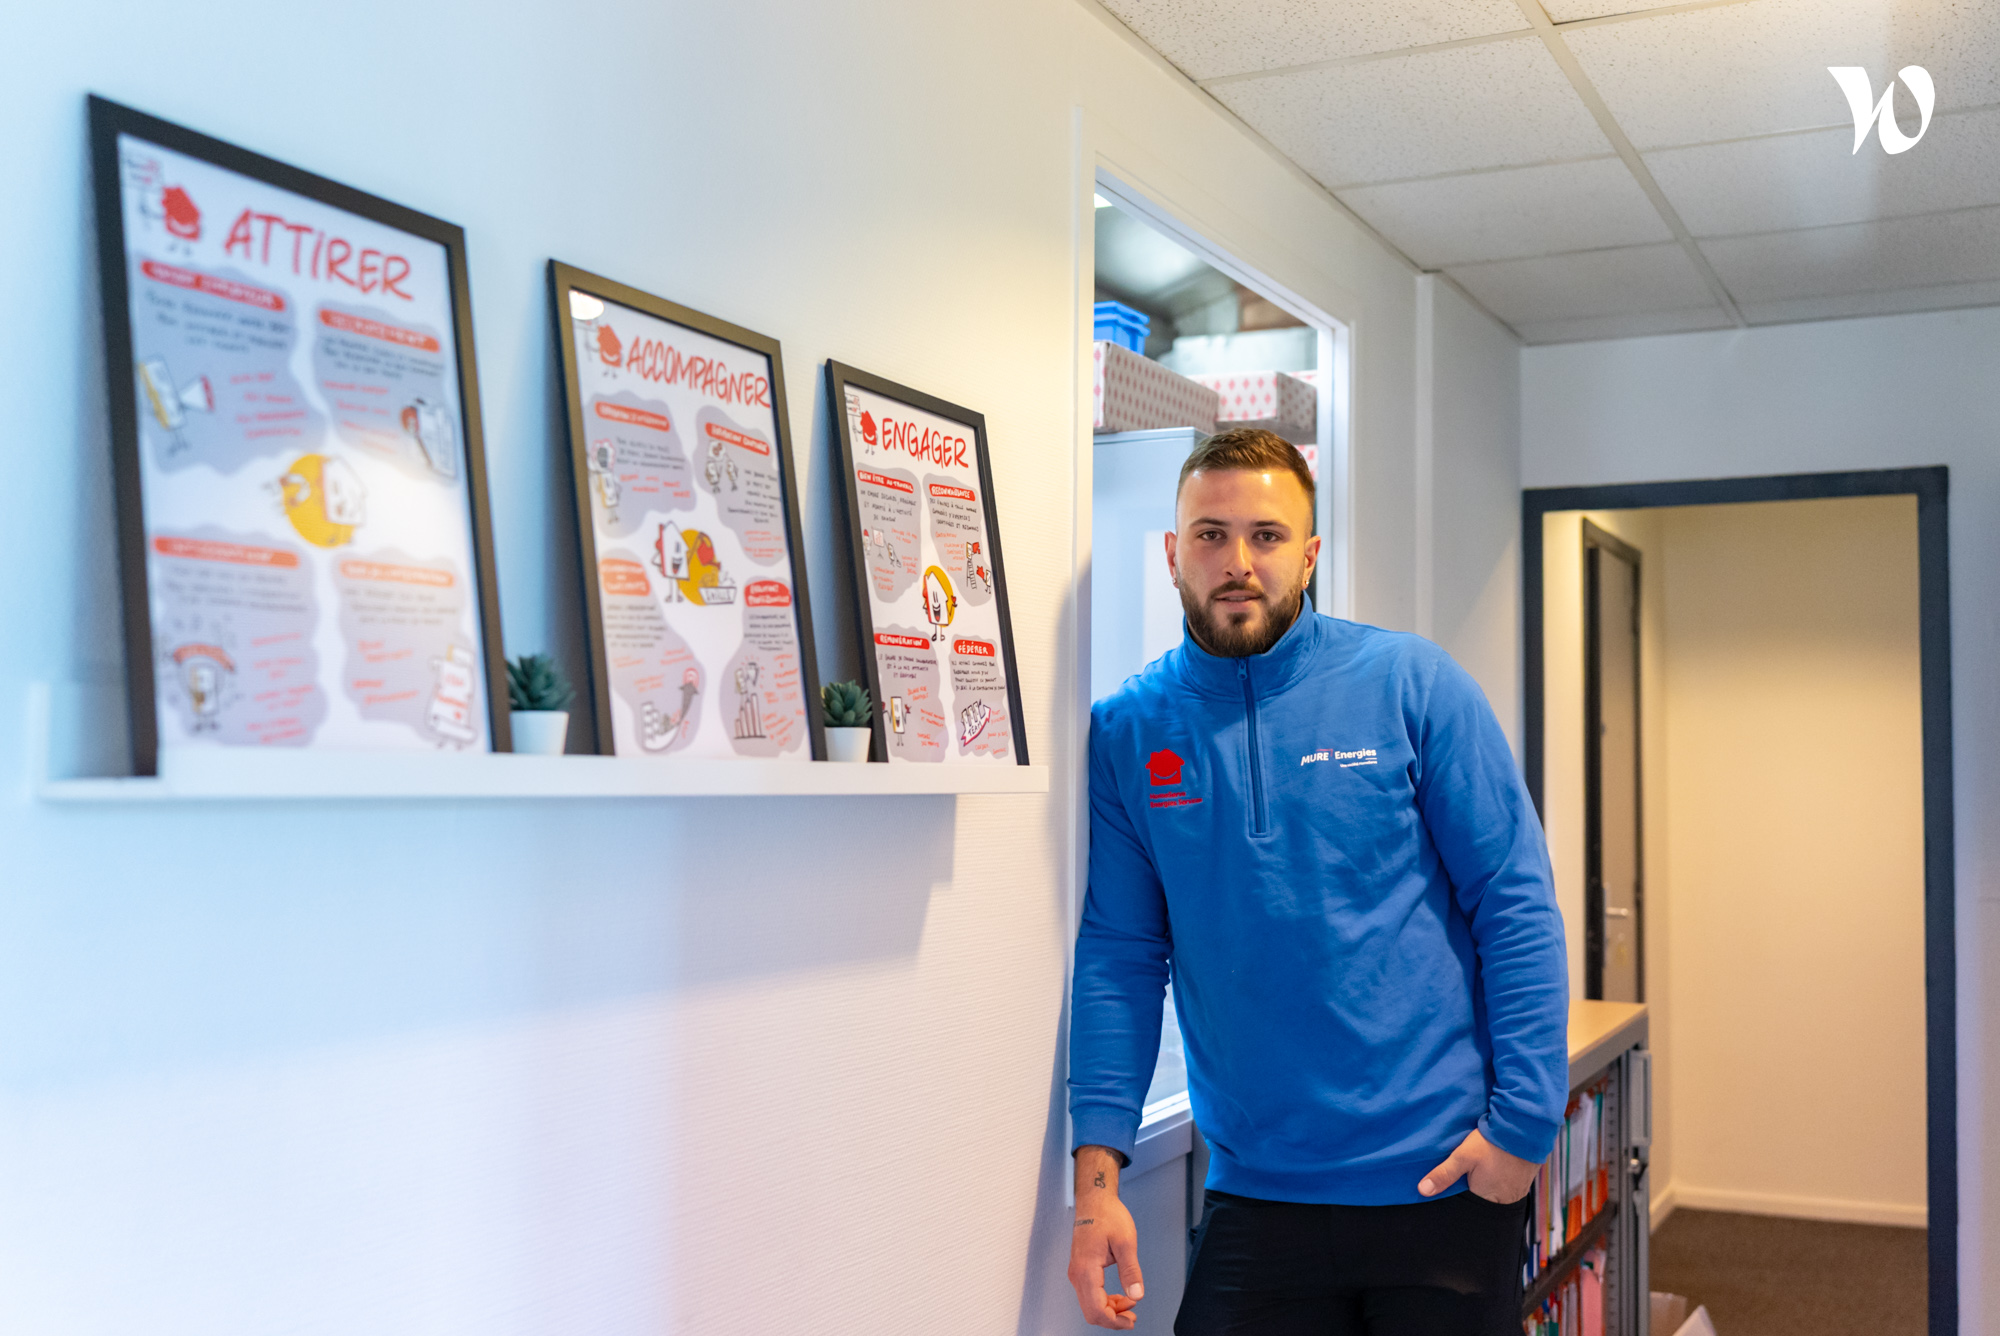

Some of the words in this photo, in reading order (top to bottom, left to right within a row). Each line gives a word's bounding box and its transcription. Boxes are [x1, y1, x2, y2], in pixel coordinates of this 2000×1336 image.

[224, 207, 414, 300] ATTIRER
[626, 336, 771, 409] ACCOMPAGNER
[882, 418, 969, 468] ENGAGER
[958, 640, 989, 655] FÉDÉRER
[968, 721, 982, 736] TEAM
[1300, 752, 1329, 766] MURE
[1334, 748, 1377, 760] Energies
